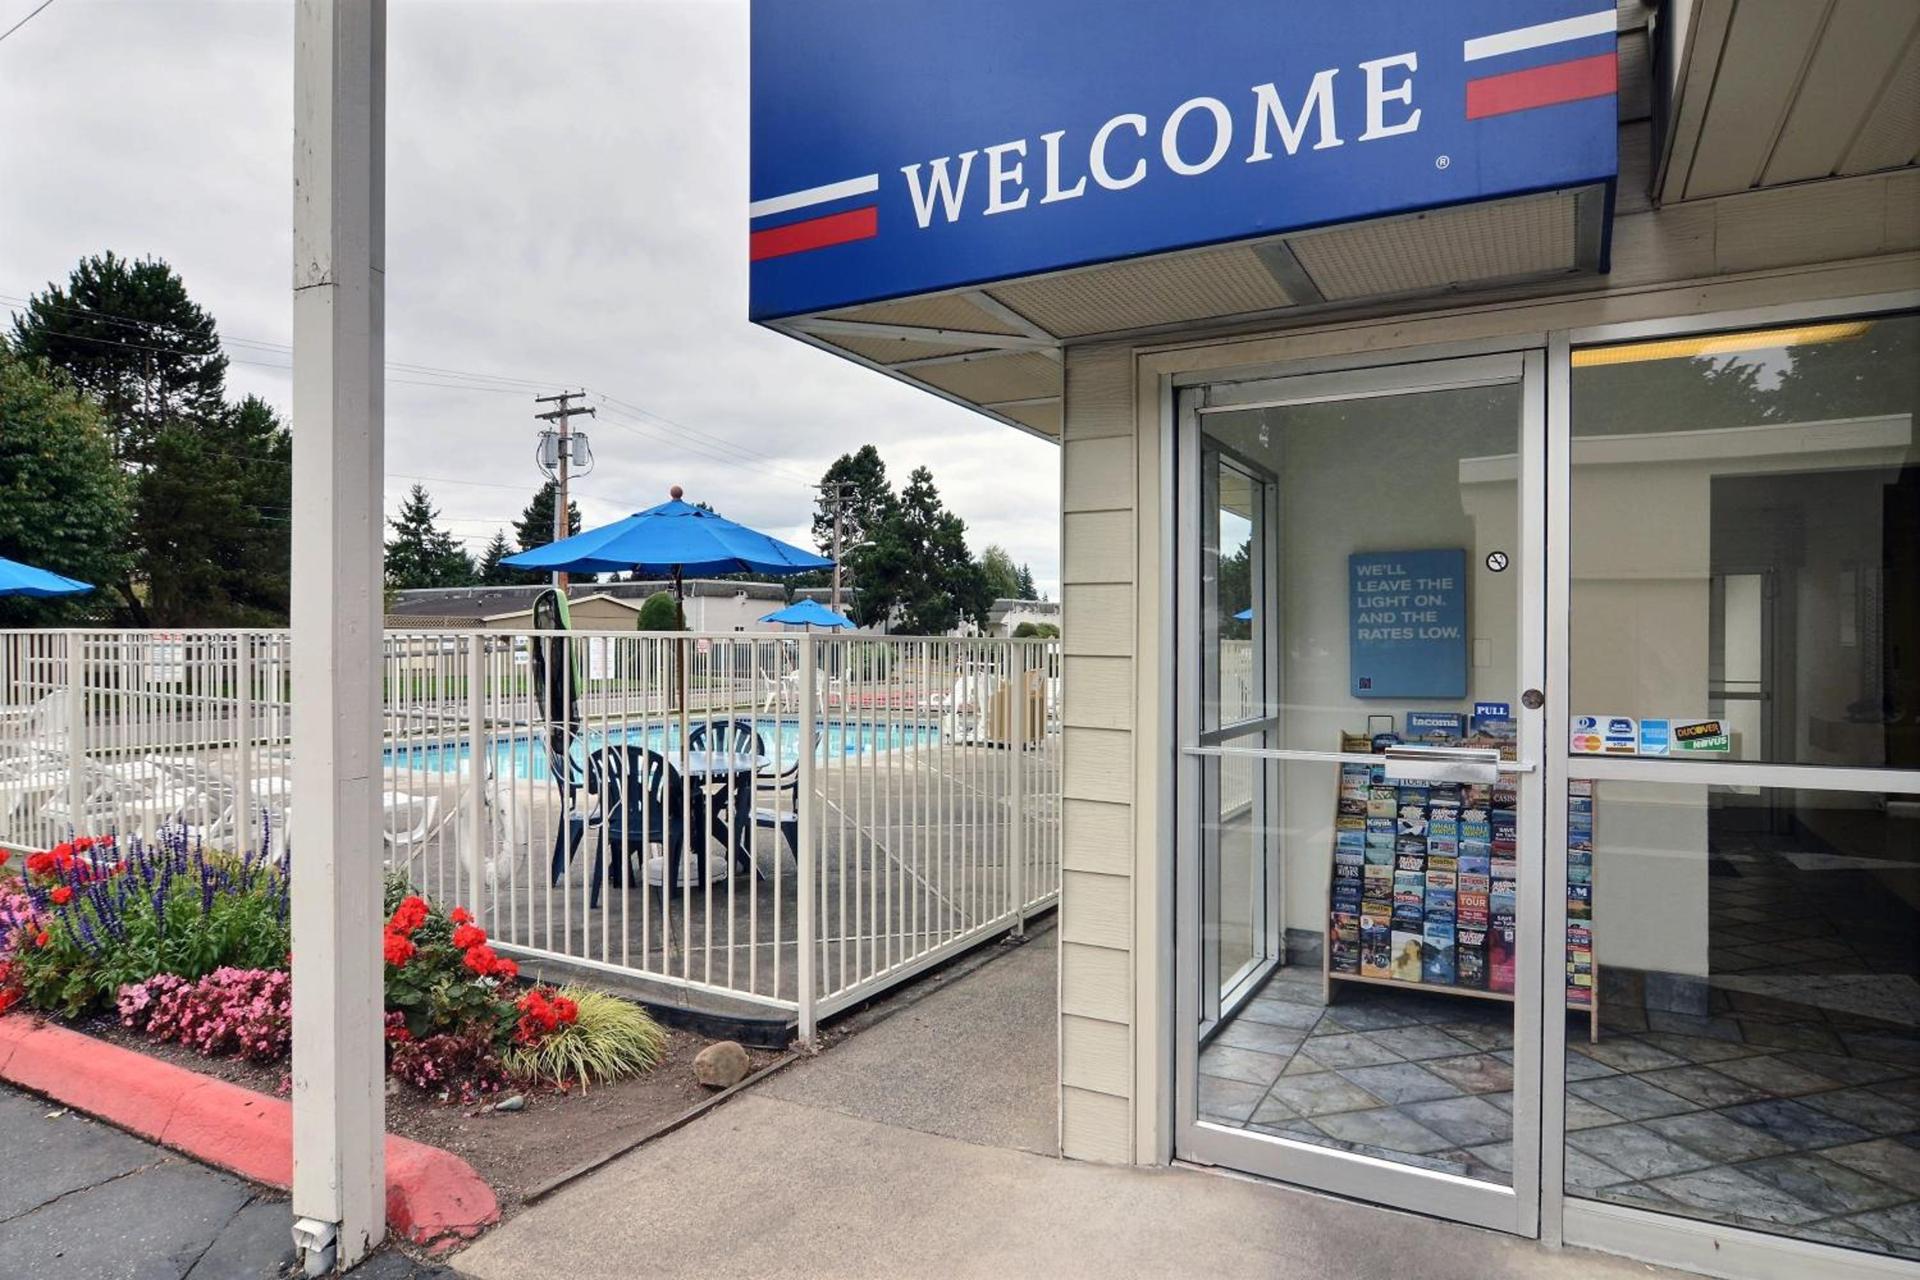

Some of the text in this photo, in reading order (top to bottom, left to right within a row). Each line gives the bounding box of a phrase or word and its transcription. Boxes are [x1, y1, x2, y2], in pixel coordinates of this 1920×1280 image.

[900, 51, 1422, 229] WELCOME
[1357, 564, 1406, 576] WE'LL
[1357, 578, 1453, 592] LEAVE THE
[1358, 595, 1447, 608] LIGHT ON.
[1358, 611, 1438, 624] AND THE
[1358, 627, 1460, 640] RATES LOW.
[1476, 705, 1508, 716] PULL
[1412, 716, 1459, 728] tacoma
[1692, 737, 1728, 749] NOVUS
[1494, 794, 1517, 803] CASIN
[1460, 897, 1487, 907] TOUR
